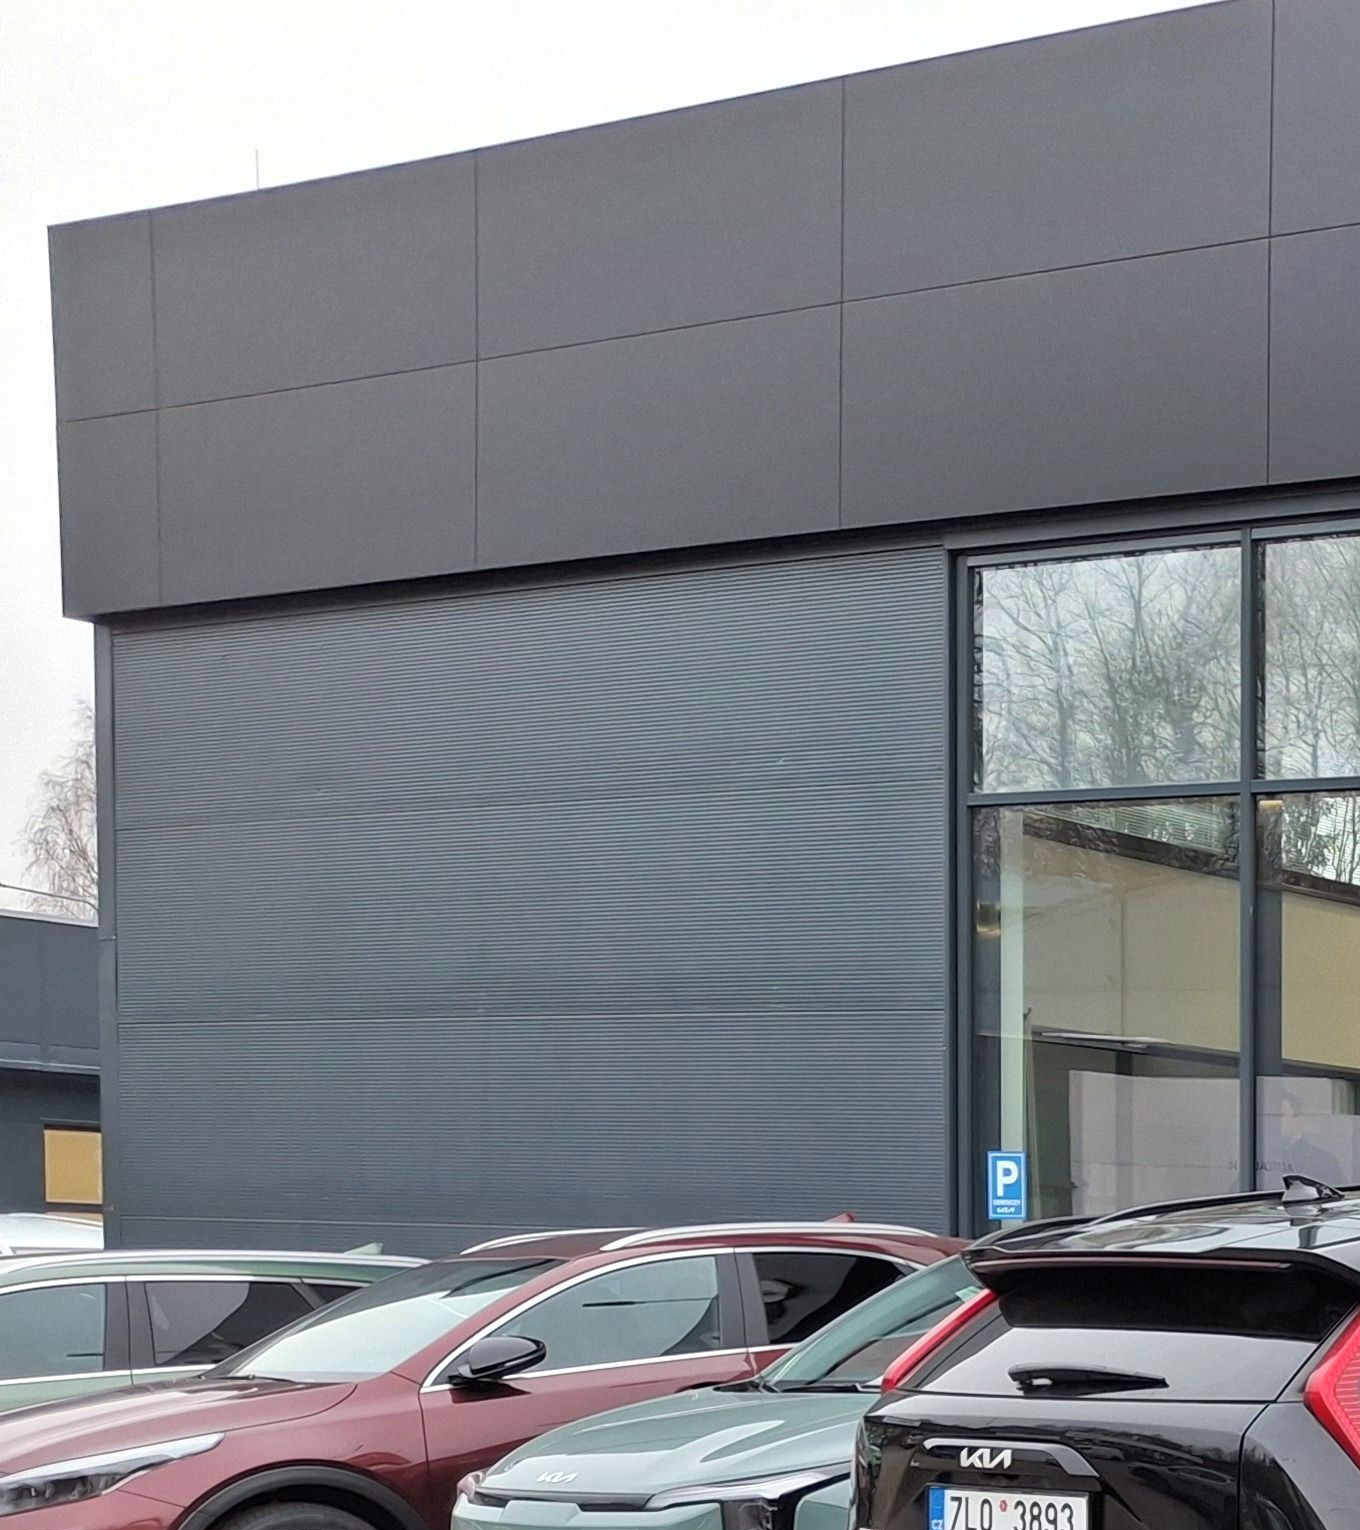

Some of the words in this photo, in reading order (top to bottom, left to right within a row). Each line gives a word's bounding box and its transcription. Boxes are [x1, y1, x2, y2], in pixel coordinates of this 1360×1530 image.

[996, 1160, 1018, 1197] P
[960, 1447, 1012, 1469] KIA
[535, 1471, 577, 1483] KIA
[931, 1519, 943, 1530] CZ
